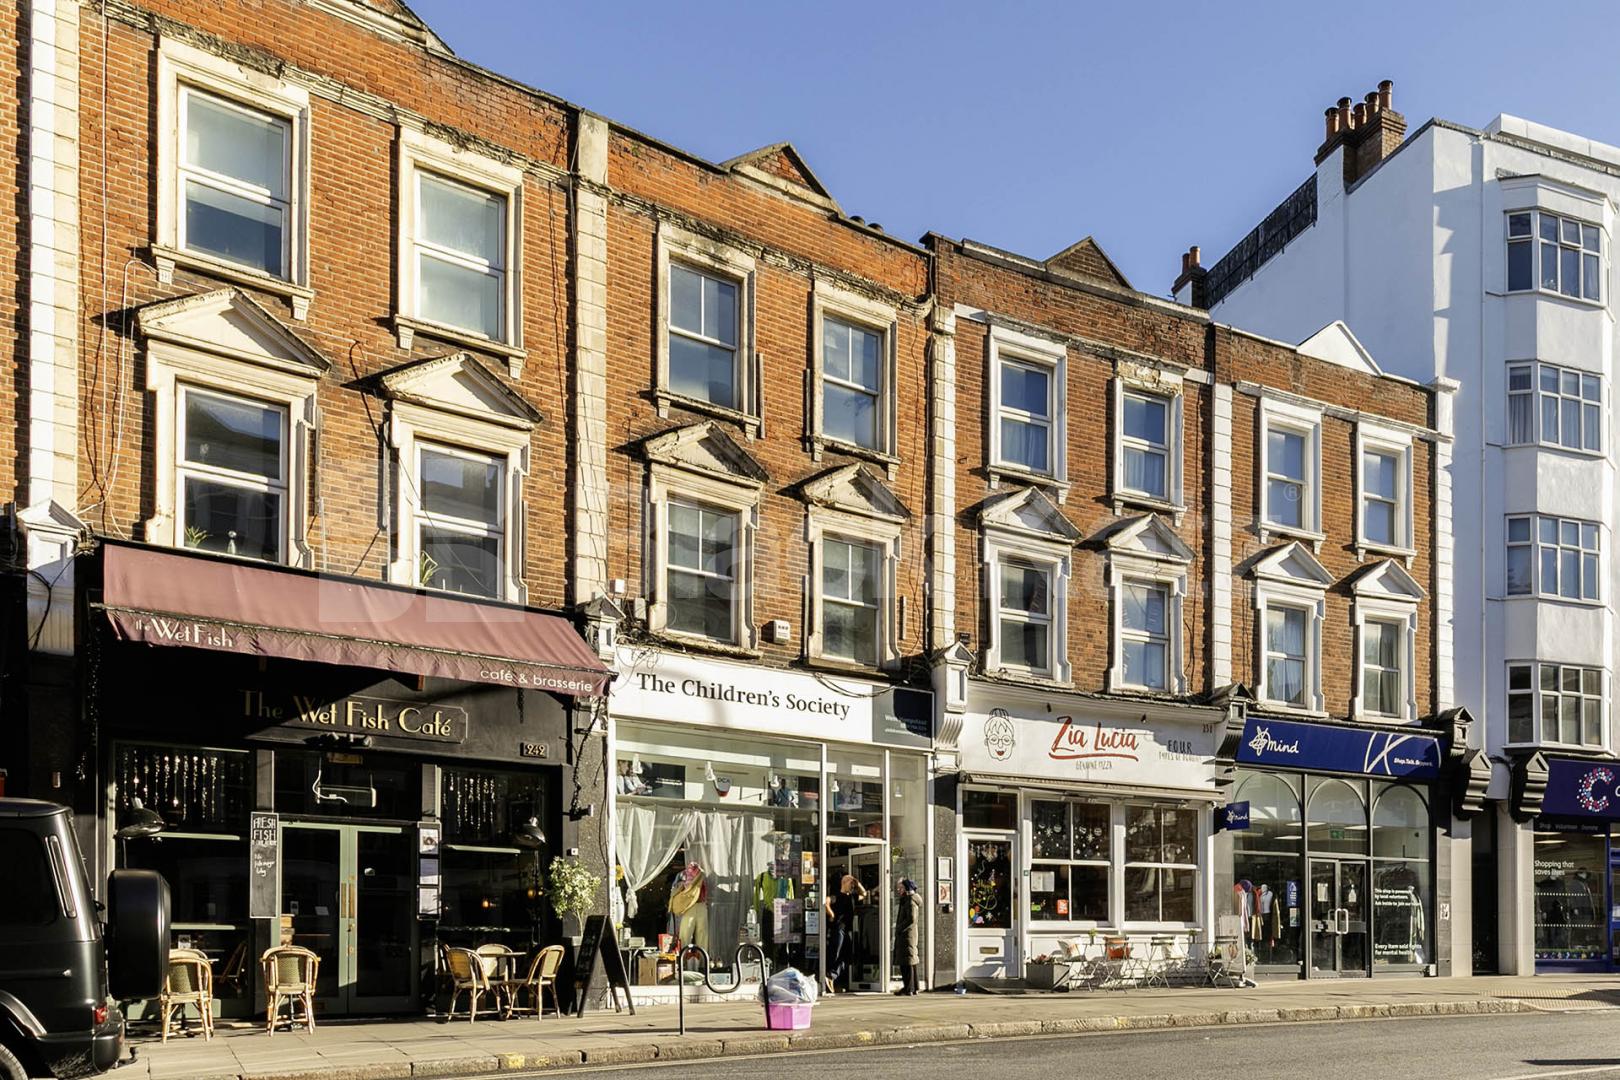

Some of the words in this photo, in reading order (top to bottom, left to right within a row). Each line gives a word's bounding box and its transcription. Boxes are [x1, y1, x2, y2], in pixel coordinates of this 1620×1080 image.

[151, 617, 190, 642] Wet
[193, 623, 234, 648] Fish
[480, 669, 513, 682] café
[518, 673, 528, 684] &
[532, 675, 593, 692] brasserie
[636, 672, 676, 694] The
[681, 678, 780, 708] Children's
[785, 693, 850, 721] Society
[240, 689, 285, 719] The
[291, 695, 338, 724] Wet
[345, 700, 389, 731] Fish
[397, 706, 452, 738] Café
[1051, 715, 1088, 753] Zia
[1094, 721, 1139, 751] Lucia
[1167, 739, 1193, 754] FOUR
[1266, 740, 1299, 753] mind
[253, 816, 276, 829] FRESH
[253, 828, 276, 841] FISH
[1534, 860, 1561, 869] Shopping
[1562, 860, 1574, 868] that
[1551, 868, 1566, 876] lives
